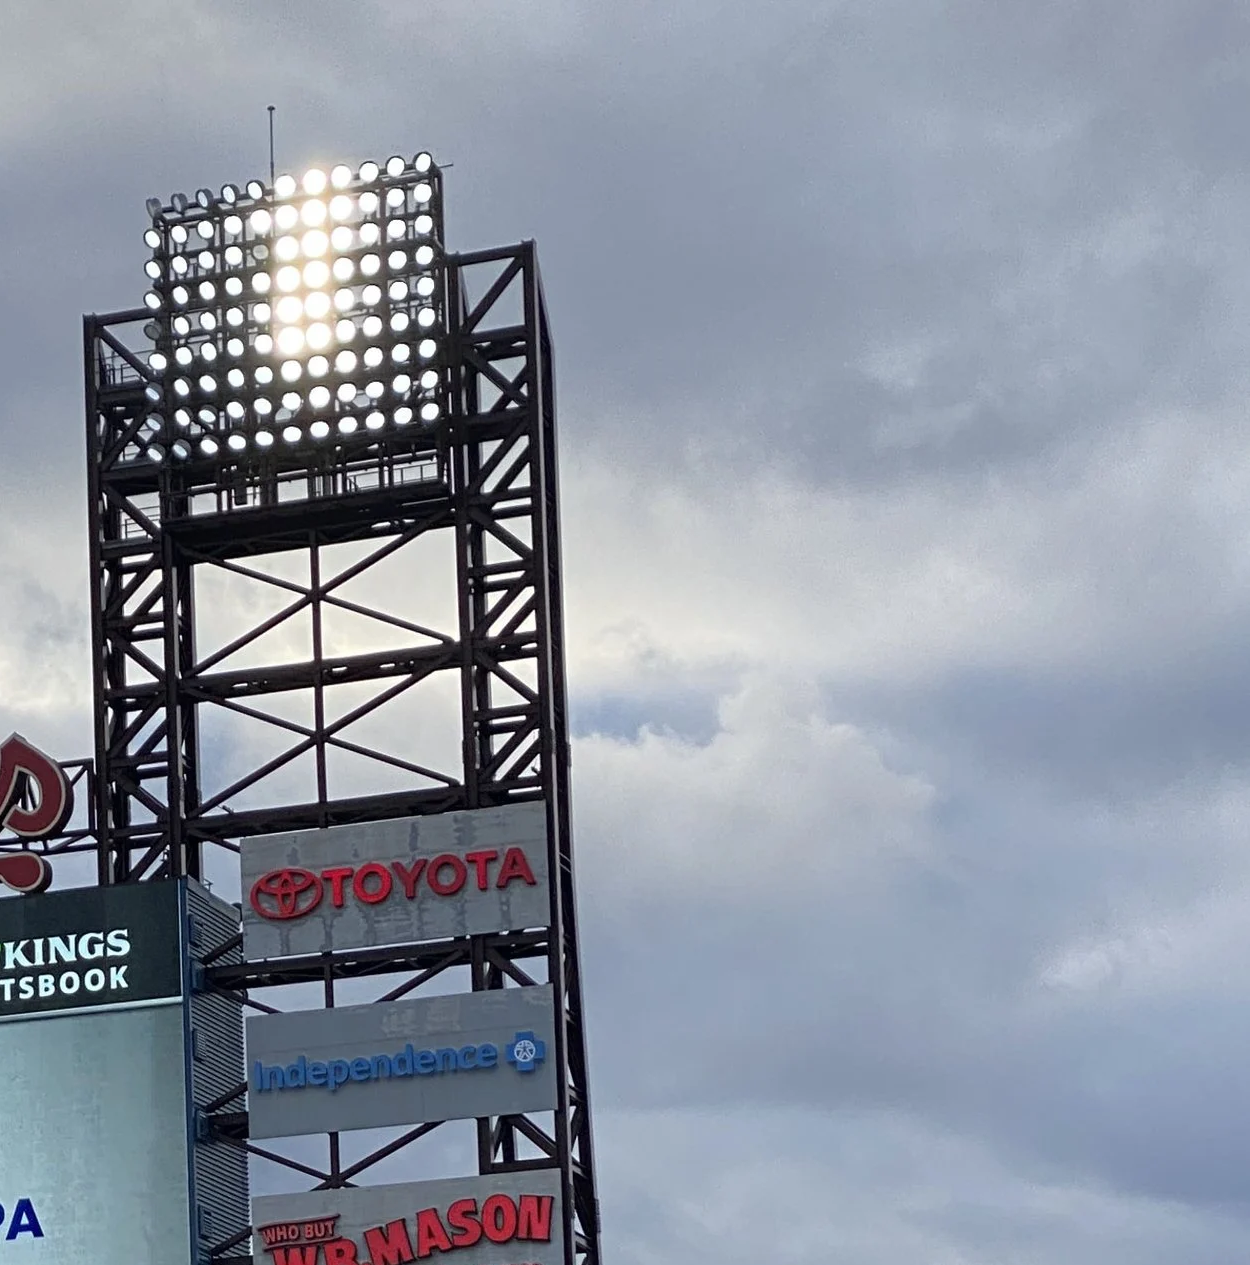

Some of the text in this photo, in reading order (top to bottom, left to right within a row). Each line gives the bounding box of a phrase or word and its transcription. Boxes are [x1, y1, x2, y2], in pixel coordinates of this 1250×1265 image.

[322, 848, 536, 909] TOYOTA
[253, 1042, 498, 1092] Independence
[261, 1220, 335, 1245] WHO BUT
